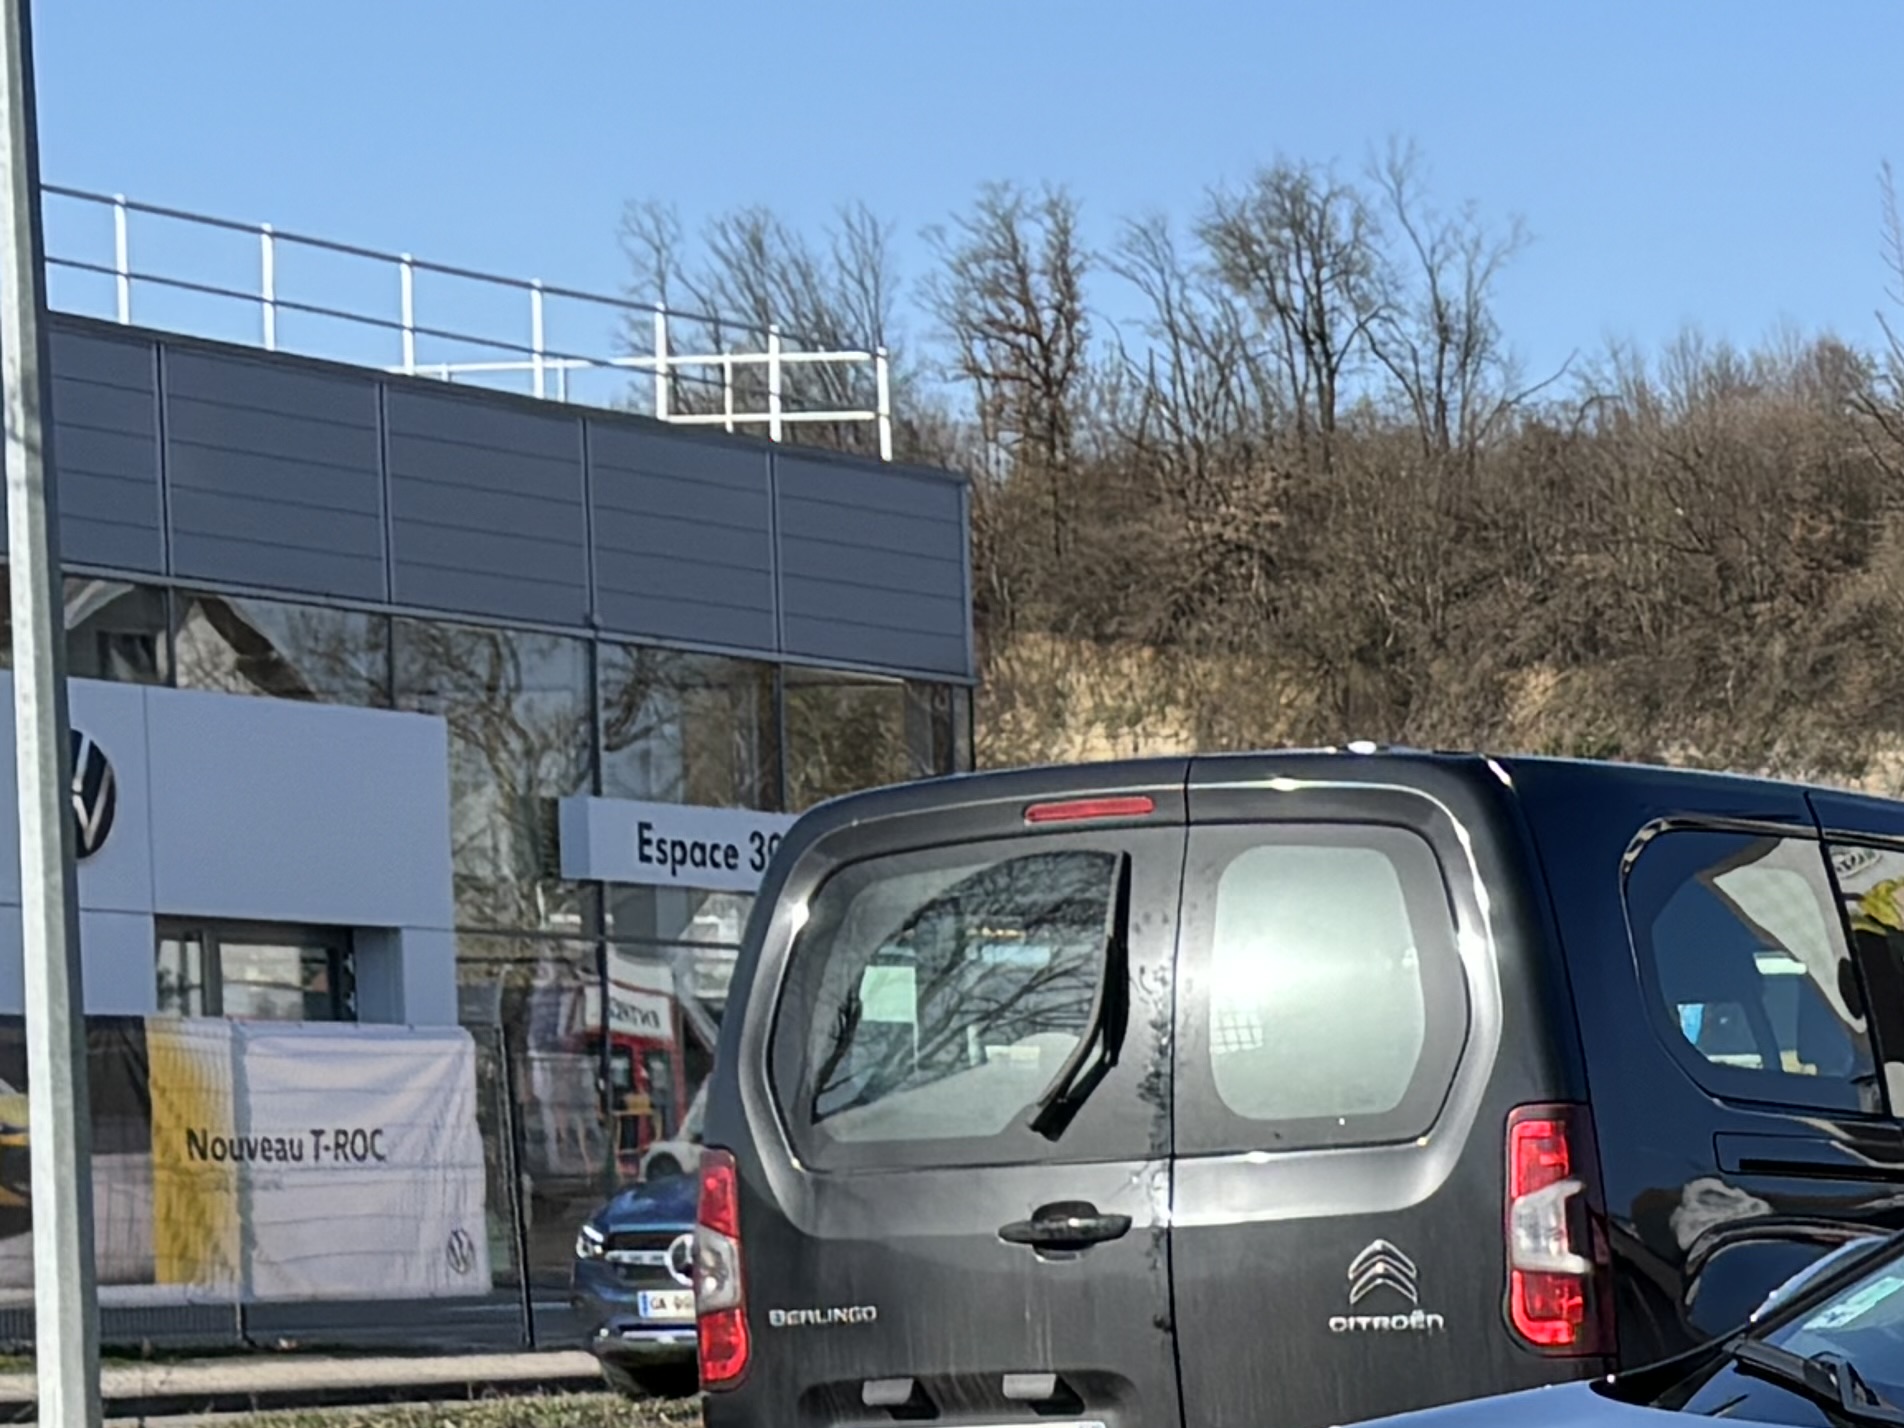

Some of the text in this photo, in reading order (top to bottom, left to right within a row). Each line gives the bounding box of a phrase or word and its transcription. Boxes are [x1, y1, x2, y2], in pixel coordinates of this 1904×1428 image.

[637, 821, 740, 876] Espace
[185, 1128, 387, 1163] Nouveau T-ROC
[768, 1305, 878, 1327] BERLINGO
